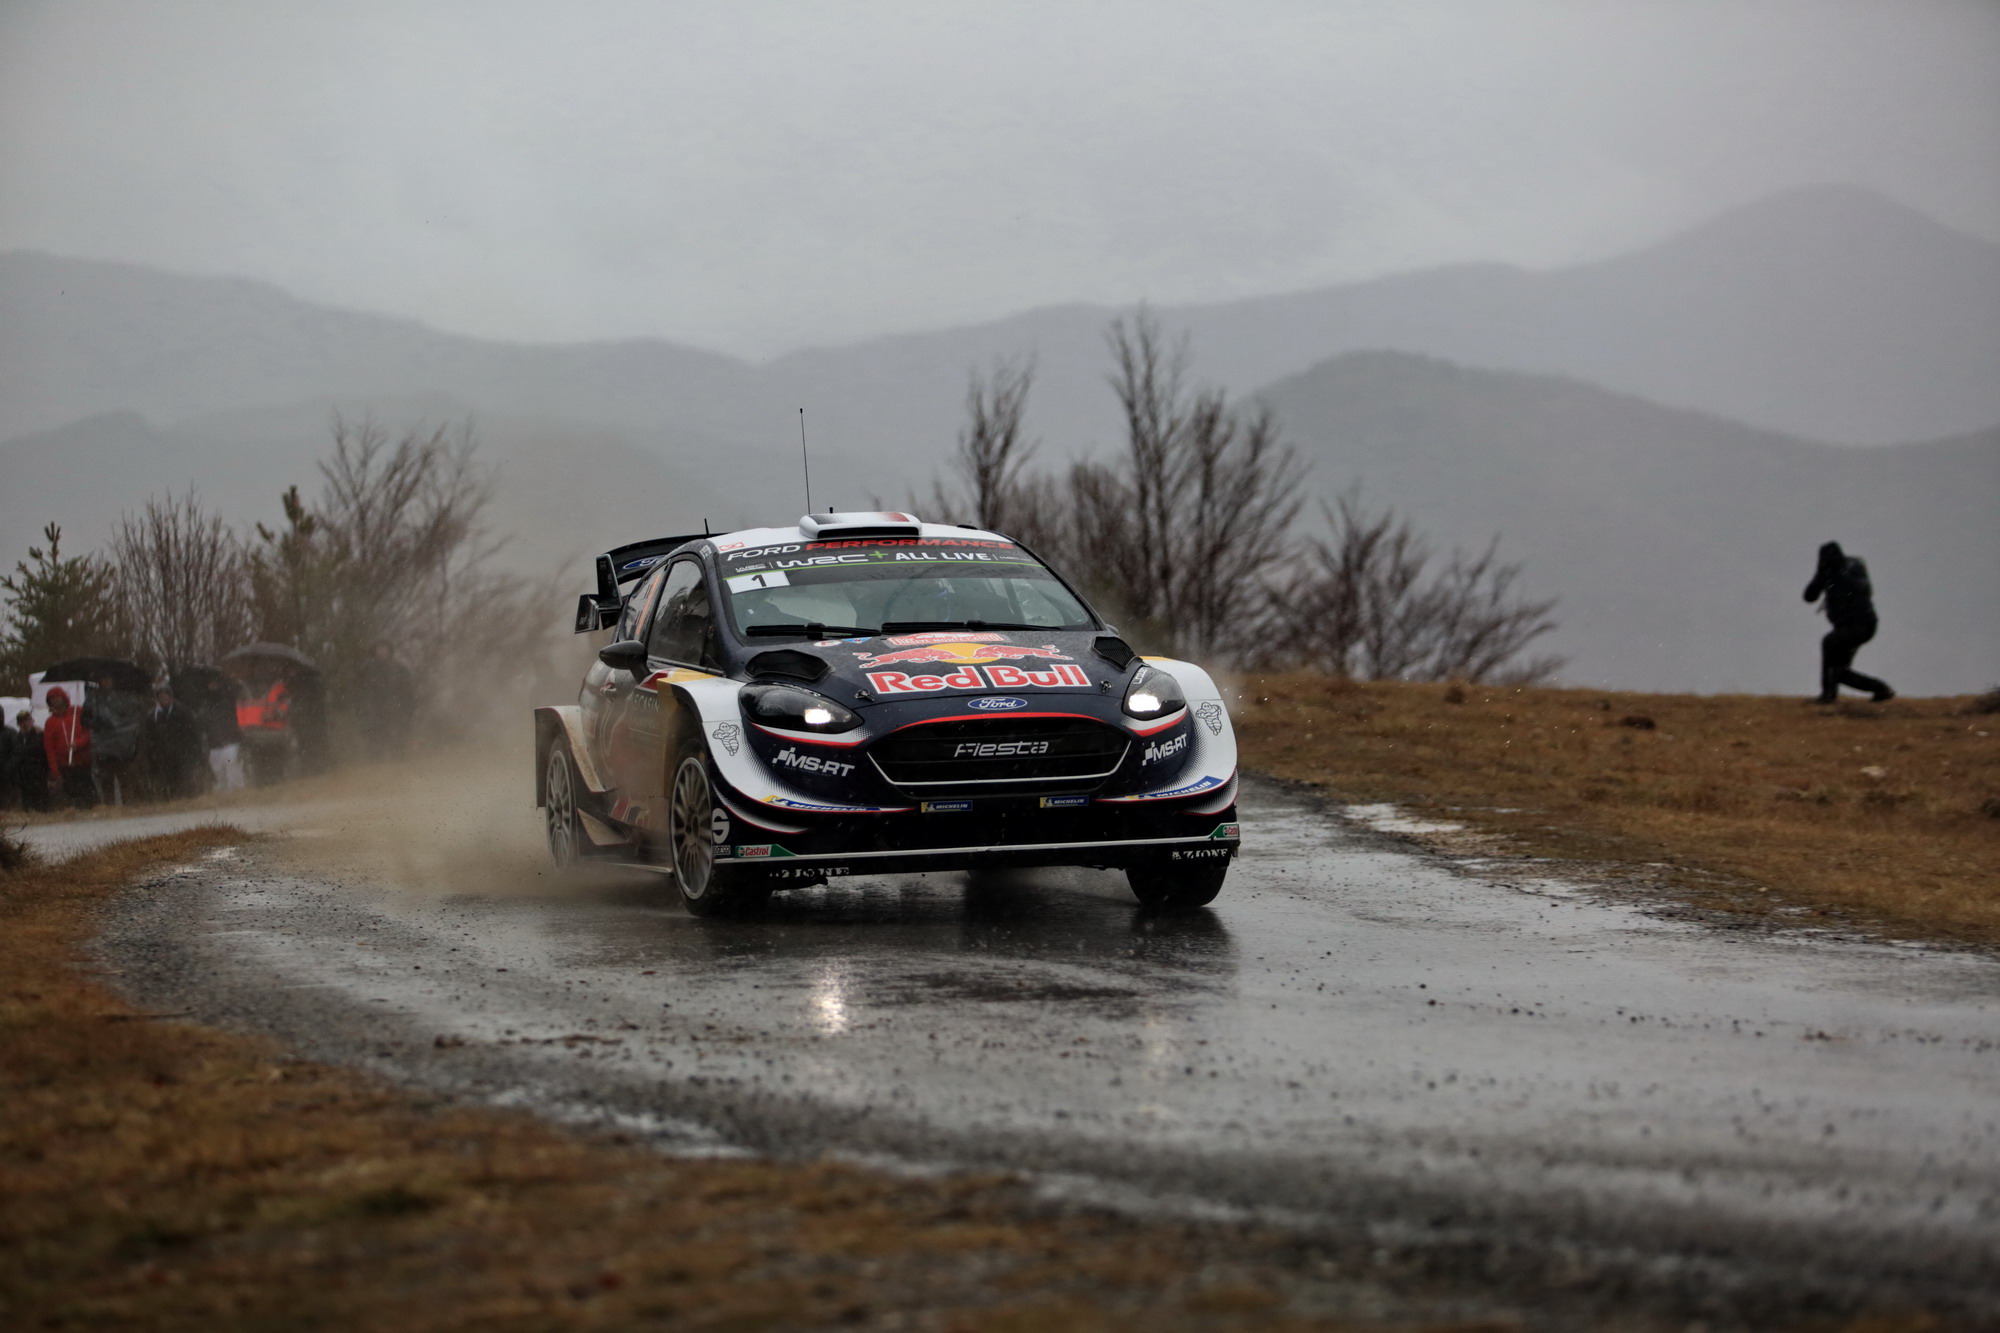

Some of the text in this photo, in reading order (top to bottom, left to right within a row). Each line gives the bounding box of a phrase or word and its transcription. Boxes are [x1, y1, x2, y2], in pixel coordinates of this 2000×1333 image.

[727, 545, 801, 561] FORD
[806, 539, 1016, 551] PERFORMANCE
[895, 552, 938, 561] ALL
[941, 552, 992, 561] LIVE
[751, 574, 767, 587] 1
[866, 664, 1092, 694] Red Bull
[978, 698, 1017, 709] Ford
[954, 741, 1049, 757] Fiesta
[1153, 733, 1187, 761] MS-RT
[785, 753, 856, 777] MS-RT
[1156, 780, 1212, 797] MICHELIN
[935, 802, 968, 810] MICHELIN
[1053, 797, 1085, 805] MICHELIN
[745, 846, 770, 856] Castrol
